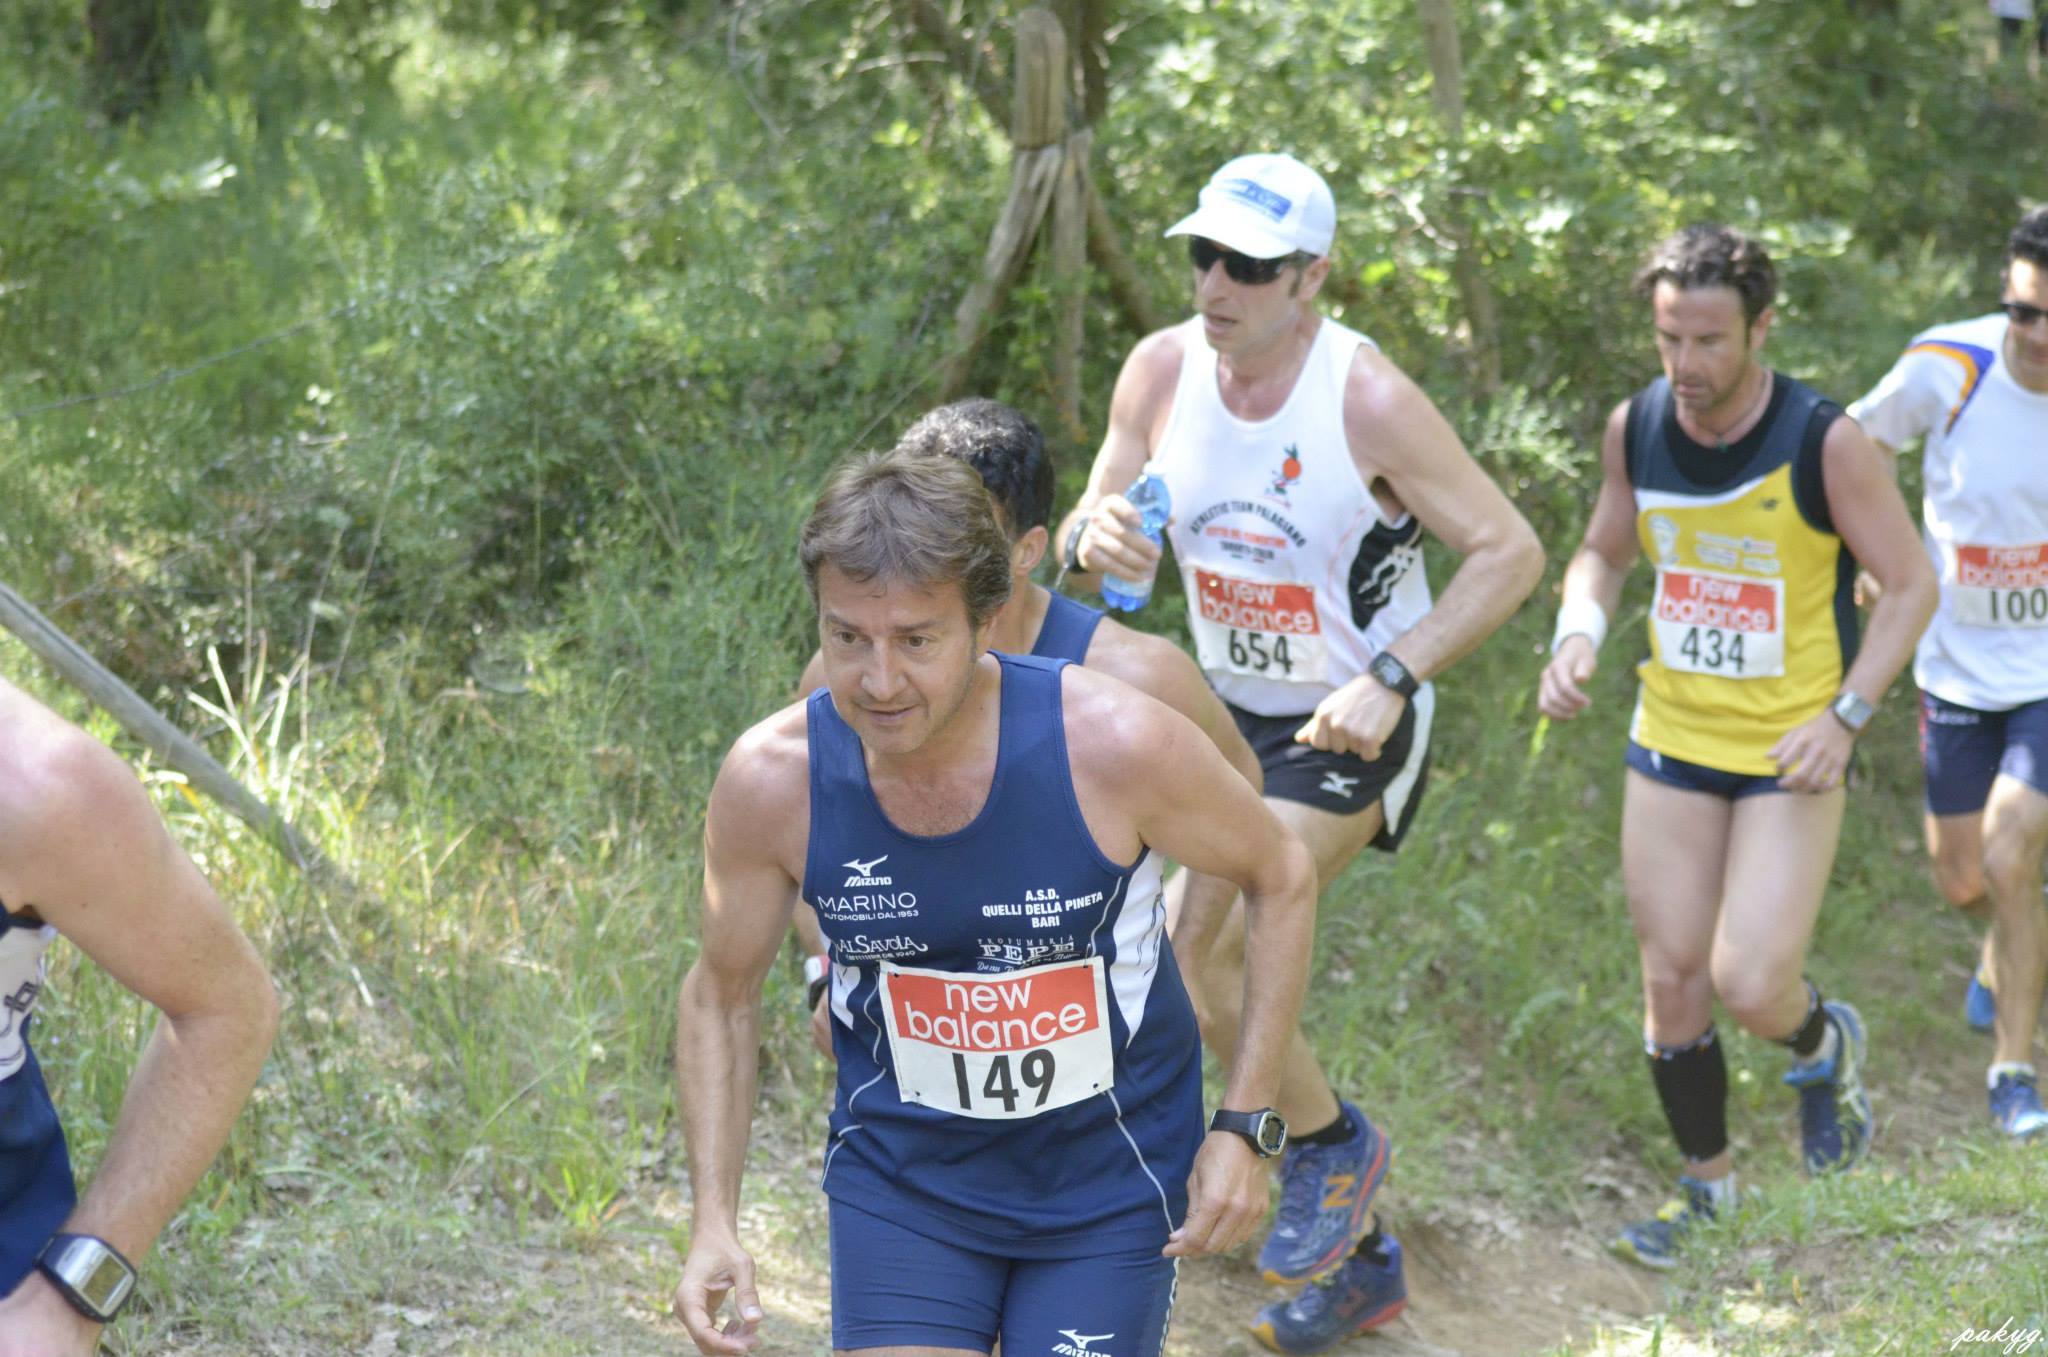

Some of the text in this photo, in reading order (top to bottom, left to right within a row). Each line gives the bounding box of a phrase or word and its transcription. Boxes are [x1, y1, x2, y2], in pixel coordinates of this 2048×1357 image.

[1221, 578, 1276, 605] new
[1689, 575, 1743, 602] new
[1201, 588, 1314, 634] balance
[1661, 591, 1771, 633] balance
[1229, 628, 1293, 675] 654
[1680, 626, 1745, 673] 434
[817, 892, 916, 912] MARINO
[982, 891, 1104, 918] QUELLI DELLA PINETA
[1025, 888, 1060, 902] A.S.D.
[878, 910, 896, 920] DAL
[897, 909, 919, 918] 1953
[1031, 915, 1060, 929] BARI
[980, 942, 1075, 962] PEPE
[944, 978, 1032, 1014] new
[904, 1000, 1087, 1050] balance
[952, 1048, 1056, 1113] 149
